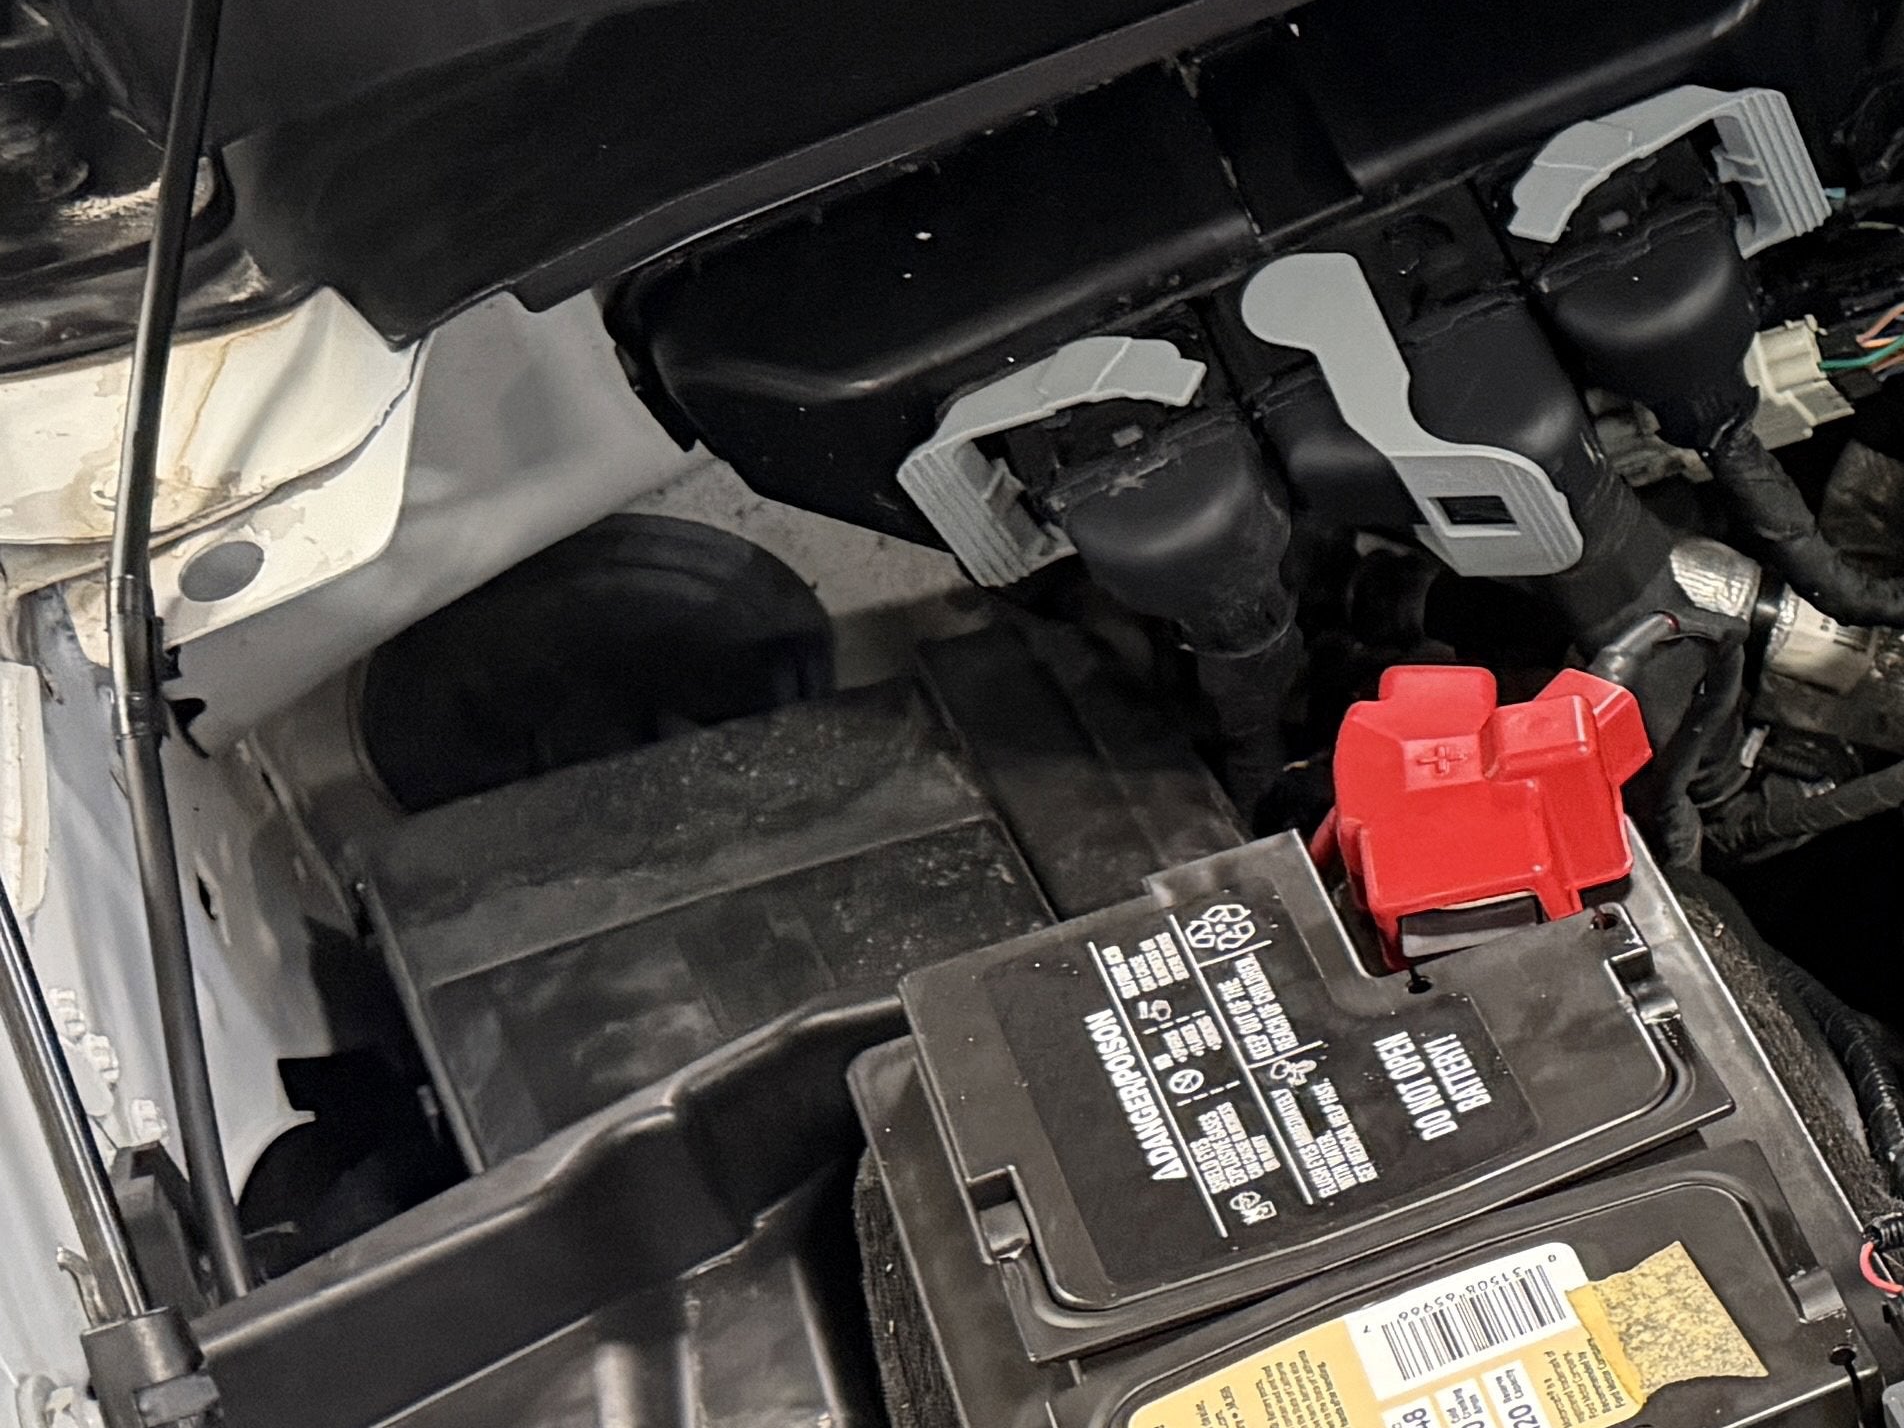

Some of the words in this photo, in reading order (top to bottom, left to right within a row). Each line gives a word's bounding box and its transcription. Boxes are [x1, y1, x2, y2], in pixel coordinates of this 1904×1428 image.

[1372, 1030, 1425, 1082] OPEN
[1422, 1030, 1492, 1114] BATTERY!
[1082, 1006, 1180, 1167] DANGER/POISON
[1396, 1073, 1444, 1116] NOT
[1413, 1106, 1458, 1141] DO
[1464, 1264, 1522, 1296] 31508
[1397, 1290, 1456, 1324] 65966
[1361, 1323, 1371, 1335] 7
[1504, 1367, 1524, 1400] Capacity
[1445, 1406, 1461, 1424] Cold
[1452, 1386, 1472, 1420] Cranking
